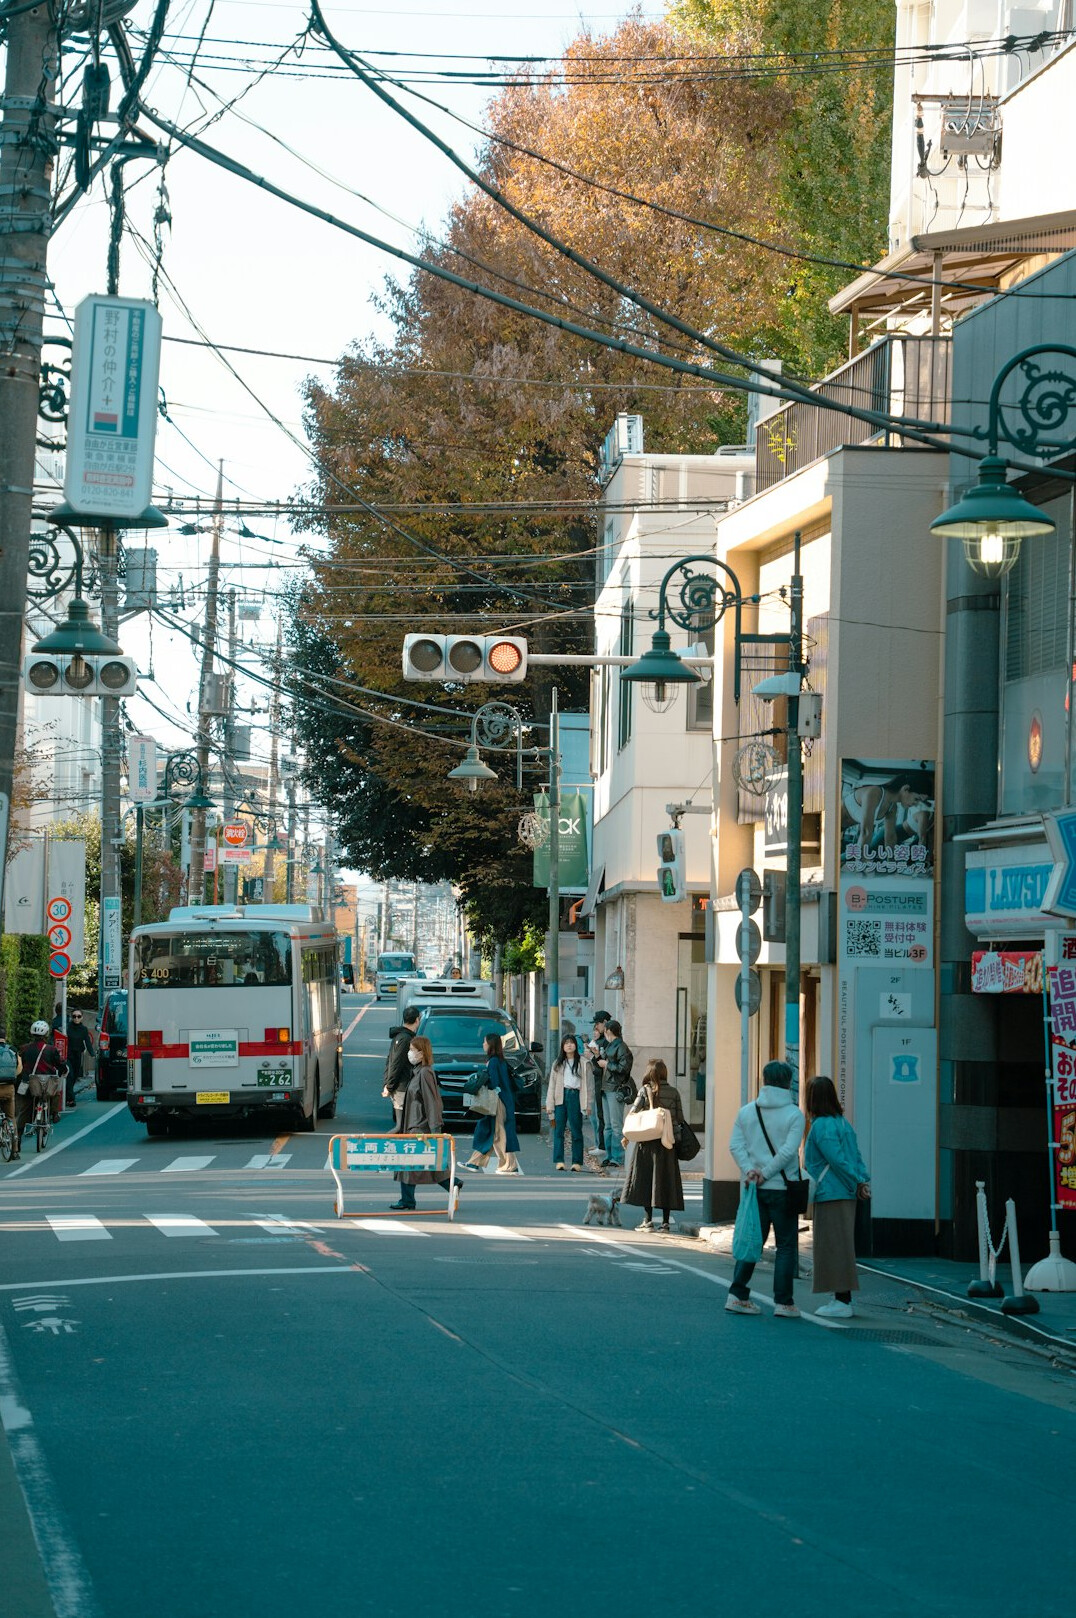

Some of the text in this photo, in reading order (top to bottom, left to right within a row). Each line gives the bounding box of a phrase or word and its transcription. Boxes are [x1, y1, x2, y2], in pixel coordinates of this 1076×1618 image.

[225, 828, 245, 838] 消火栓
[845, 843, 927, 861] 美しい姿勢
[845, 860, 927, 874] マシンピラティス
[53, 904, 67, 916] 30
[885, 921, 927, 933] 無料体験
[885, 933, 916, 943] 受付中
[885, 948, 926, 958] 当ビル3F
[141, 968, 169, 978] S 400
[890, 976, 901, 984] 2F
[901, 1038, 912, 1046] 1F
[1057, 1051, 1076, 1076] お
[347, 1140, 435, 1153] 車両通行止
